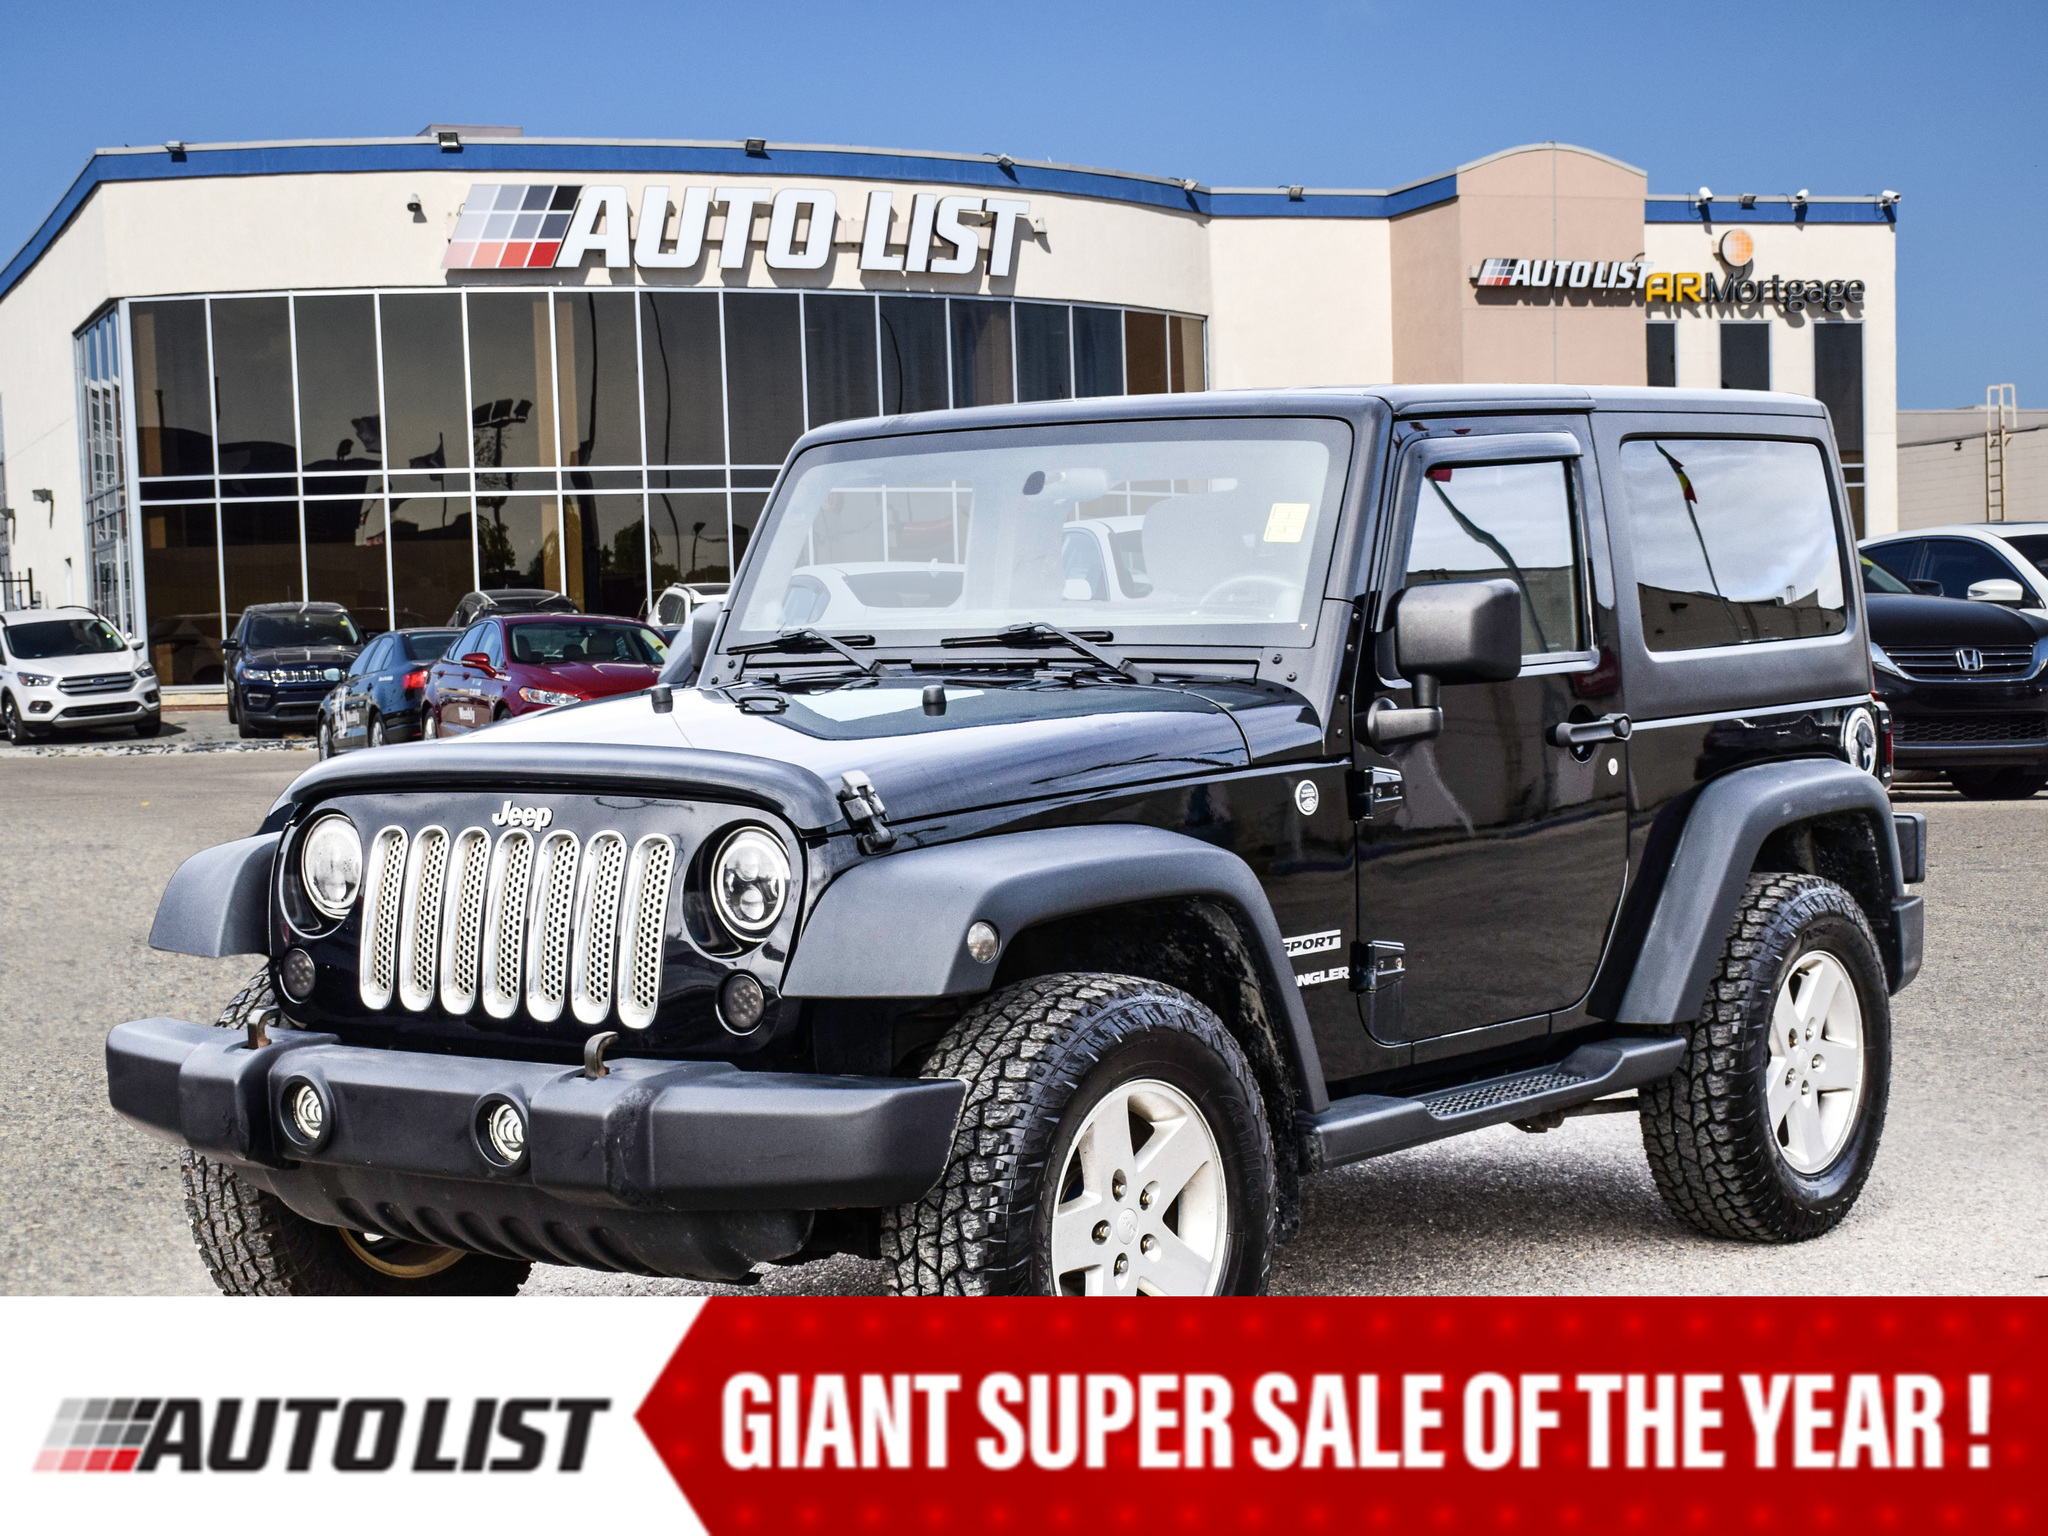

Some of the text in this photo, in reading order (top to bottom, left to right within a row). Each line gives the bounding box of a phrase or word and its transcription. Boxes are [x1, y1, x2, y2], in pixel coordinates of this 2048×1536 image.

[554, 184, 1031, 278] AUTO LIST
[1509, 259, 1654, 290] AUTO LIST
[1645, 272, 1866, 313] AR Mortgage
[491, 800, 554, 833] Jeep
[1294, 966, 1350, 987] NGLER
